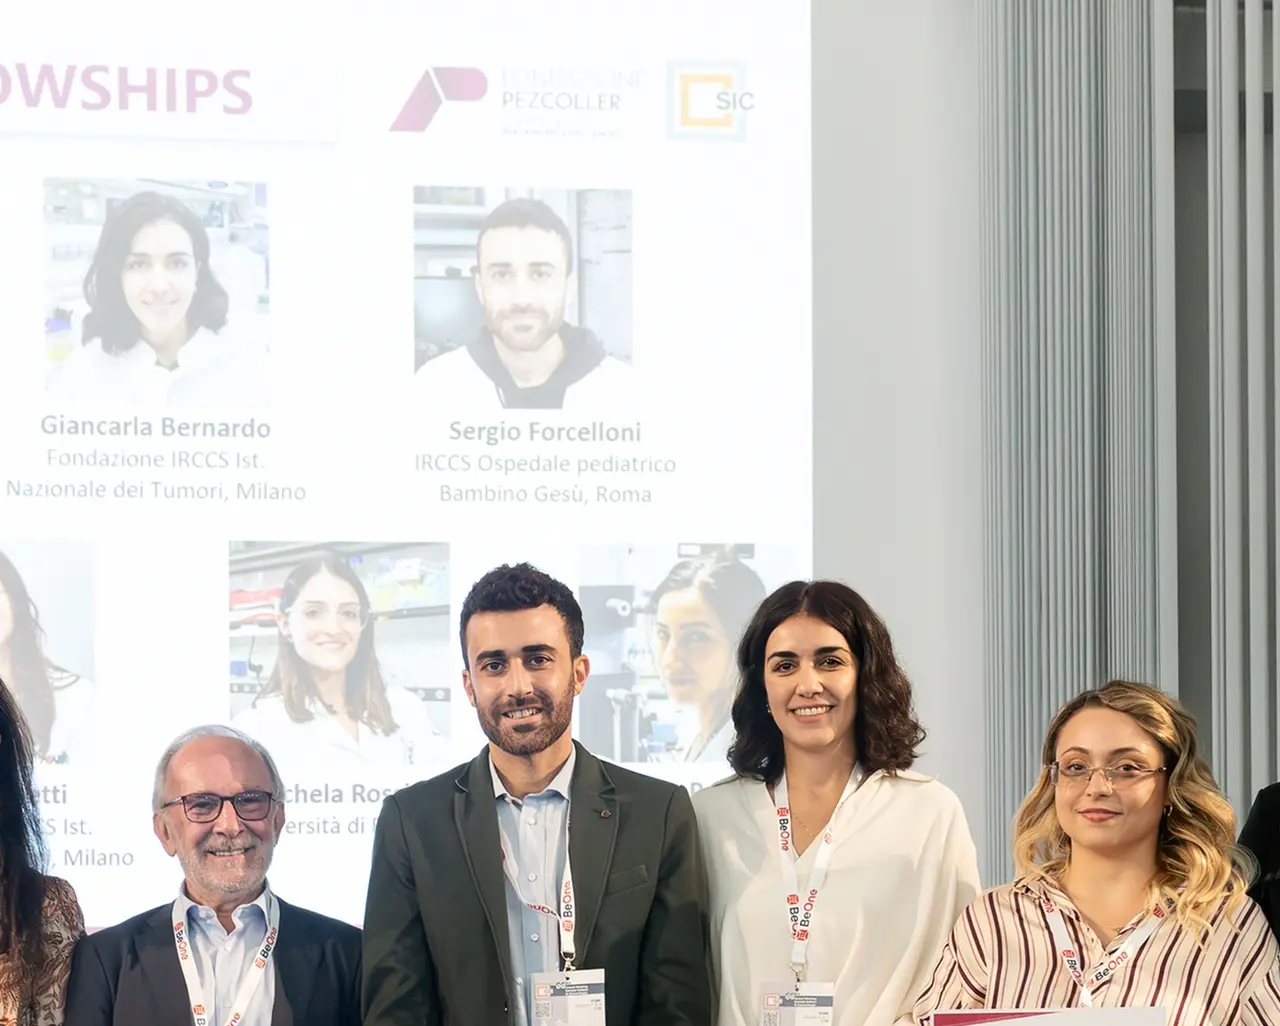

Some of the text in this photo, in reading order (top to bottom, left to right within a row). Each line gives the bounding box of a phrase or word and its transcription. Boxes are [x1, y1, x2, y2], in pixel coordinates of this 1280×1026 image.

[502, 91, 621, 111] PEZCOLLER
[715, 91, 754, 111] SIC
[40, 415, 271, 438] Giancarla Bernardo
[449, 421, 641, 445] Sergio Forcelloni
[47, 448, 264, 469] Fondazione IRCCS Ist.
[415, 453, 676, 477] IRCCS Ospedale pediatrico
[6, 479, 306, 502] Nazionale dei Tumori, Milano
[440, 484, 652, 505] Bambino Gesù, Roma
[285, 783, 343, 803] chela
[64, 819, 93, 835] Ist.
[285, 816, 365, 834] ersità di
[778, 817, 790, 852] BeOne
[64, 849, 134, 866] Milano
[563, 880, 573, 918] BeOne
[799, 888, 818, 928] BeOne
[260, 926, 278, 959] BeOne
[1094, 951, 1129, 982] BeOne
